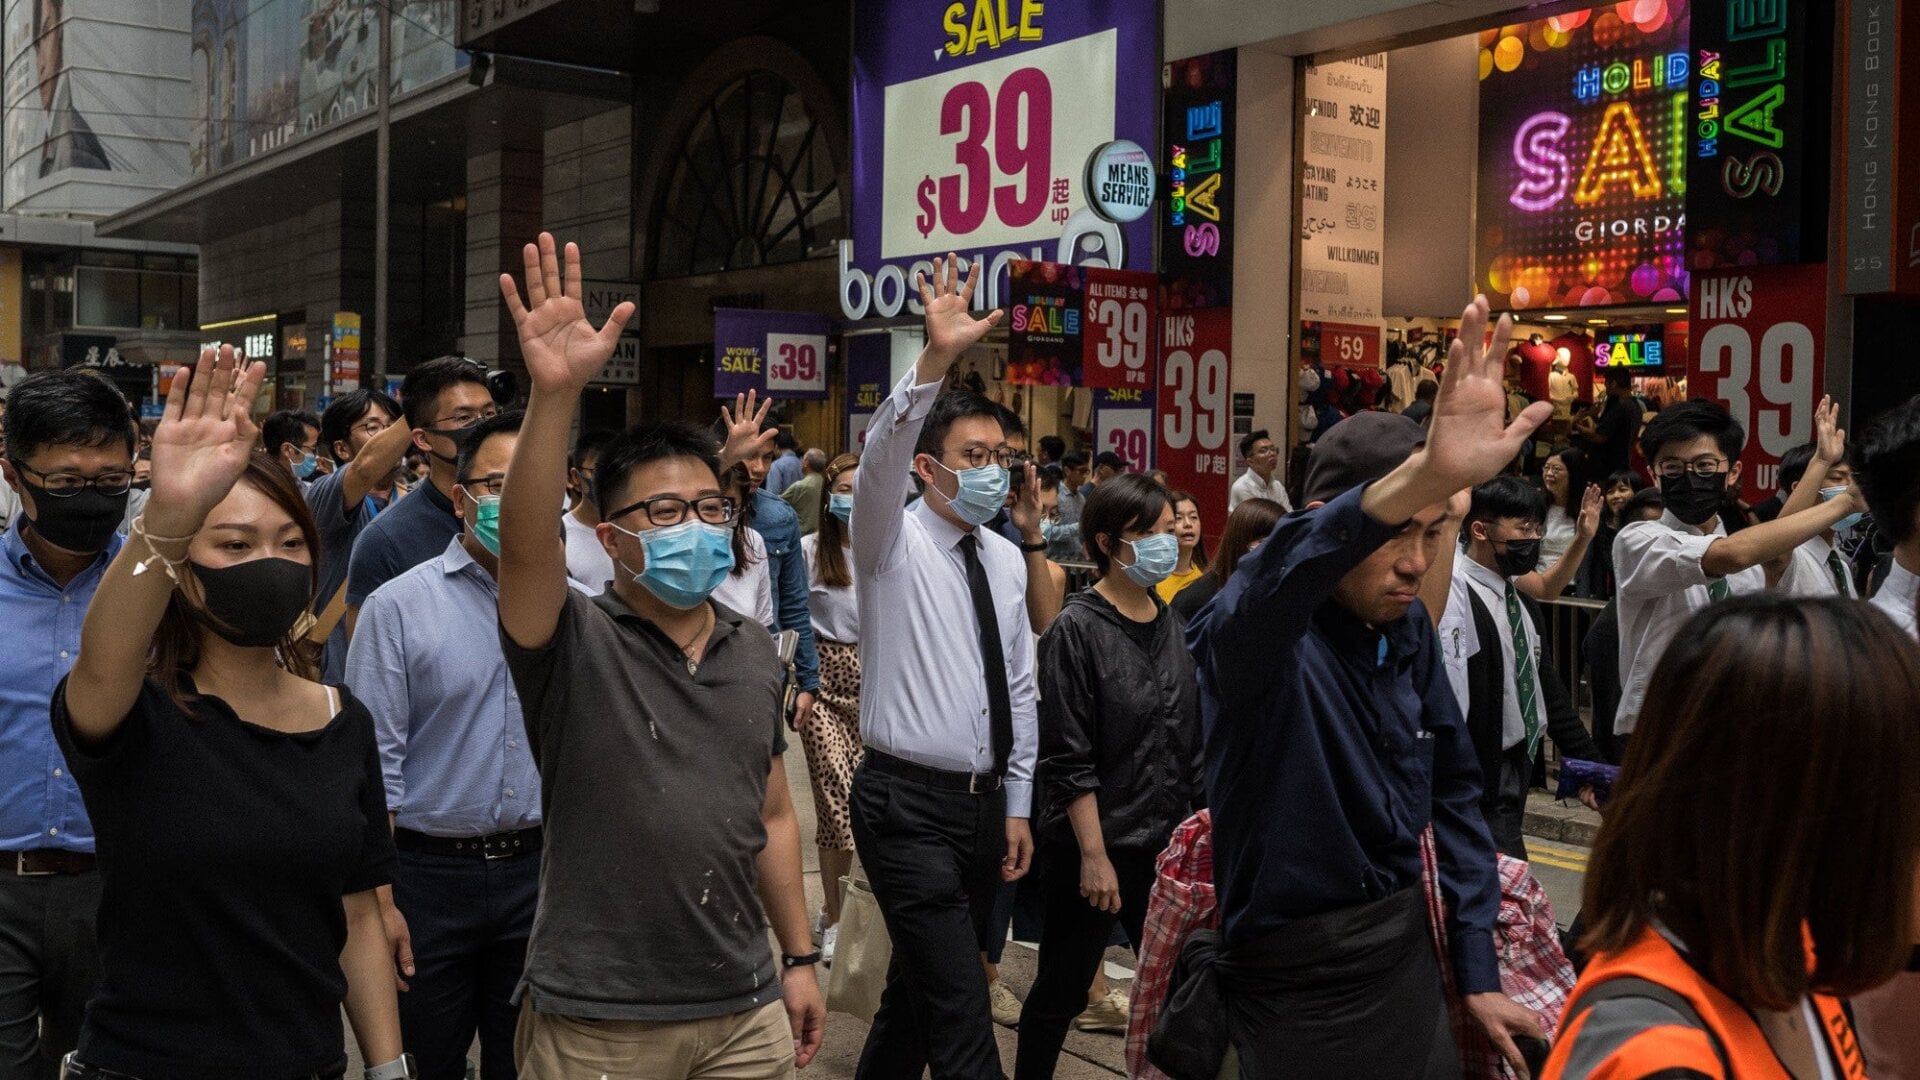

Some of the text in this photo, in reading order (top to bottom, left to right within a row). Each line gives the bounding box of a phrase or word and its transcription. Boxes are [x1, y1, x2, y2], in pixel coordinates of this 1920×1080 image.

[943, 0, 1044, 57] SALE
[1698, 49, 1721, 157] HOLIDAY
[1722, 0, 1788, 198] SALE
[1349, 104, 1381, 129] 欢迎
[1863, 4, 1881, 230] HONG KONG BOOK
[916, 67, 1053, 238] $39
[1108, 164, 1149, 186] MEANS
[1171, 144, 1188, 227] HOLIDAY
[1183, 100, 1222, 257] SALE
[1346, 176, 1378, 192] ようこそ
[1052, 178, 1070, 205] 起
[1102, 182, 1150, 208] SERVICE
[1051, 207, 1070, 226] up
[1327, 246, 1380, 266] WILLKOMMEN
[1854, 257, 1882, 270] 25
[1090, 283, 1103, 298] ALL
[1104, 284, 1127, 299] ITEMS
[1700, 277, 1752, 320] HK$
[1011, 304, 1079, 334] SALE
[1165, 315, 1195, 347] HK$
[1027, 335, 1065, 344] GIORDANO
[1089, 299, 1148, 369] $39
[612, 343, 636, 359] AN
[1334, 335, 1364, 361] $59
[1595, 341, 1663, 367] SALE
[720, 356, 762, 375] SALE
[771, 343, 816, 381] $39
[856, 391, 882, 408] SALE
[1164, 349, 1229, 450] 39
[1700, 322, 1814, 458] 39
[1108, 428, 1147, 475] 39
[1196, 454, 1227, 475] UP 起
